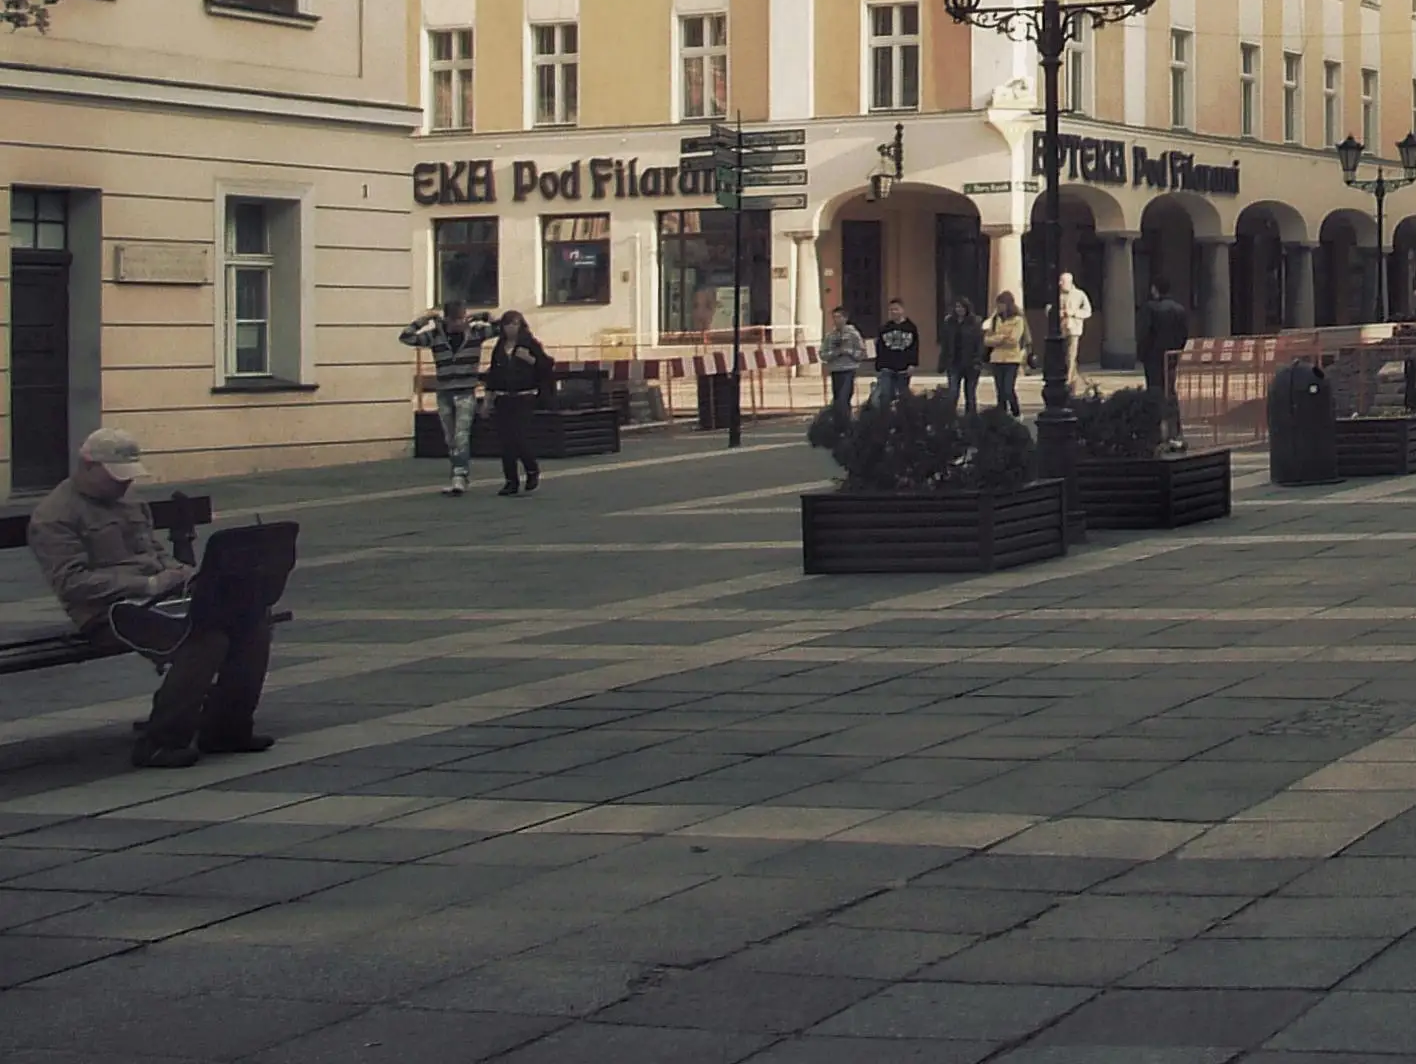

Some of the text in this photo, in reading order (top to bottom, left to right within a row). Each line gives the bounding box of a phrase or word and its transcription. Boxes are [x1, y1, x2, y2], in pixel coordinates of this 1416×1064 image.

[413, 159, 497, 204] EKA
[512, 159, 582, 202] Pod
[1132, 145, 1168, 190] Pod
